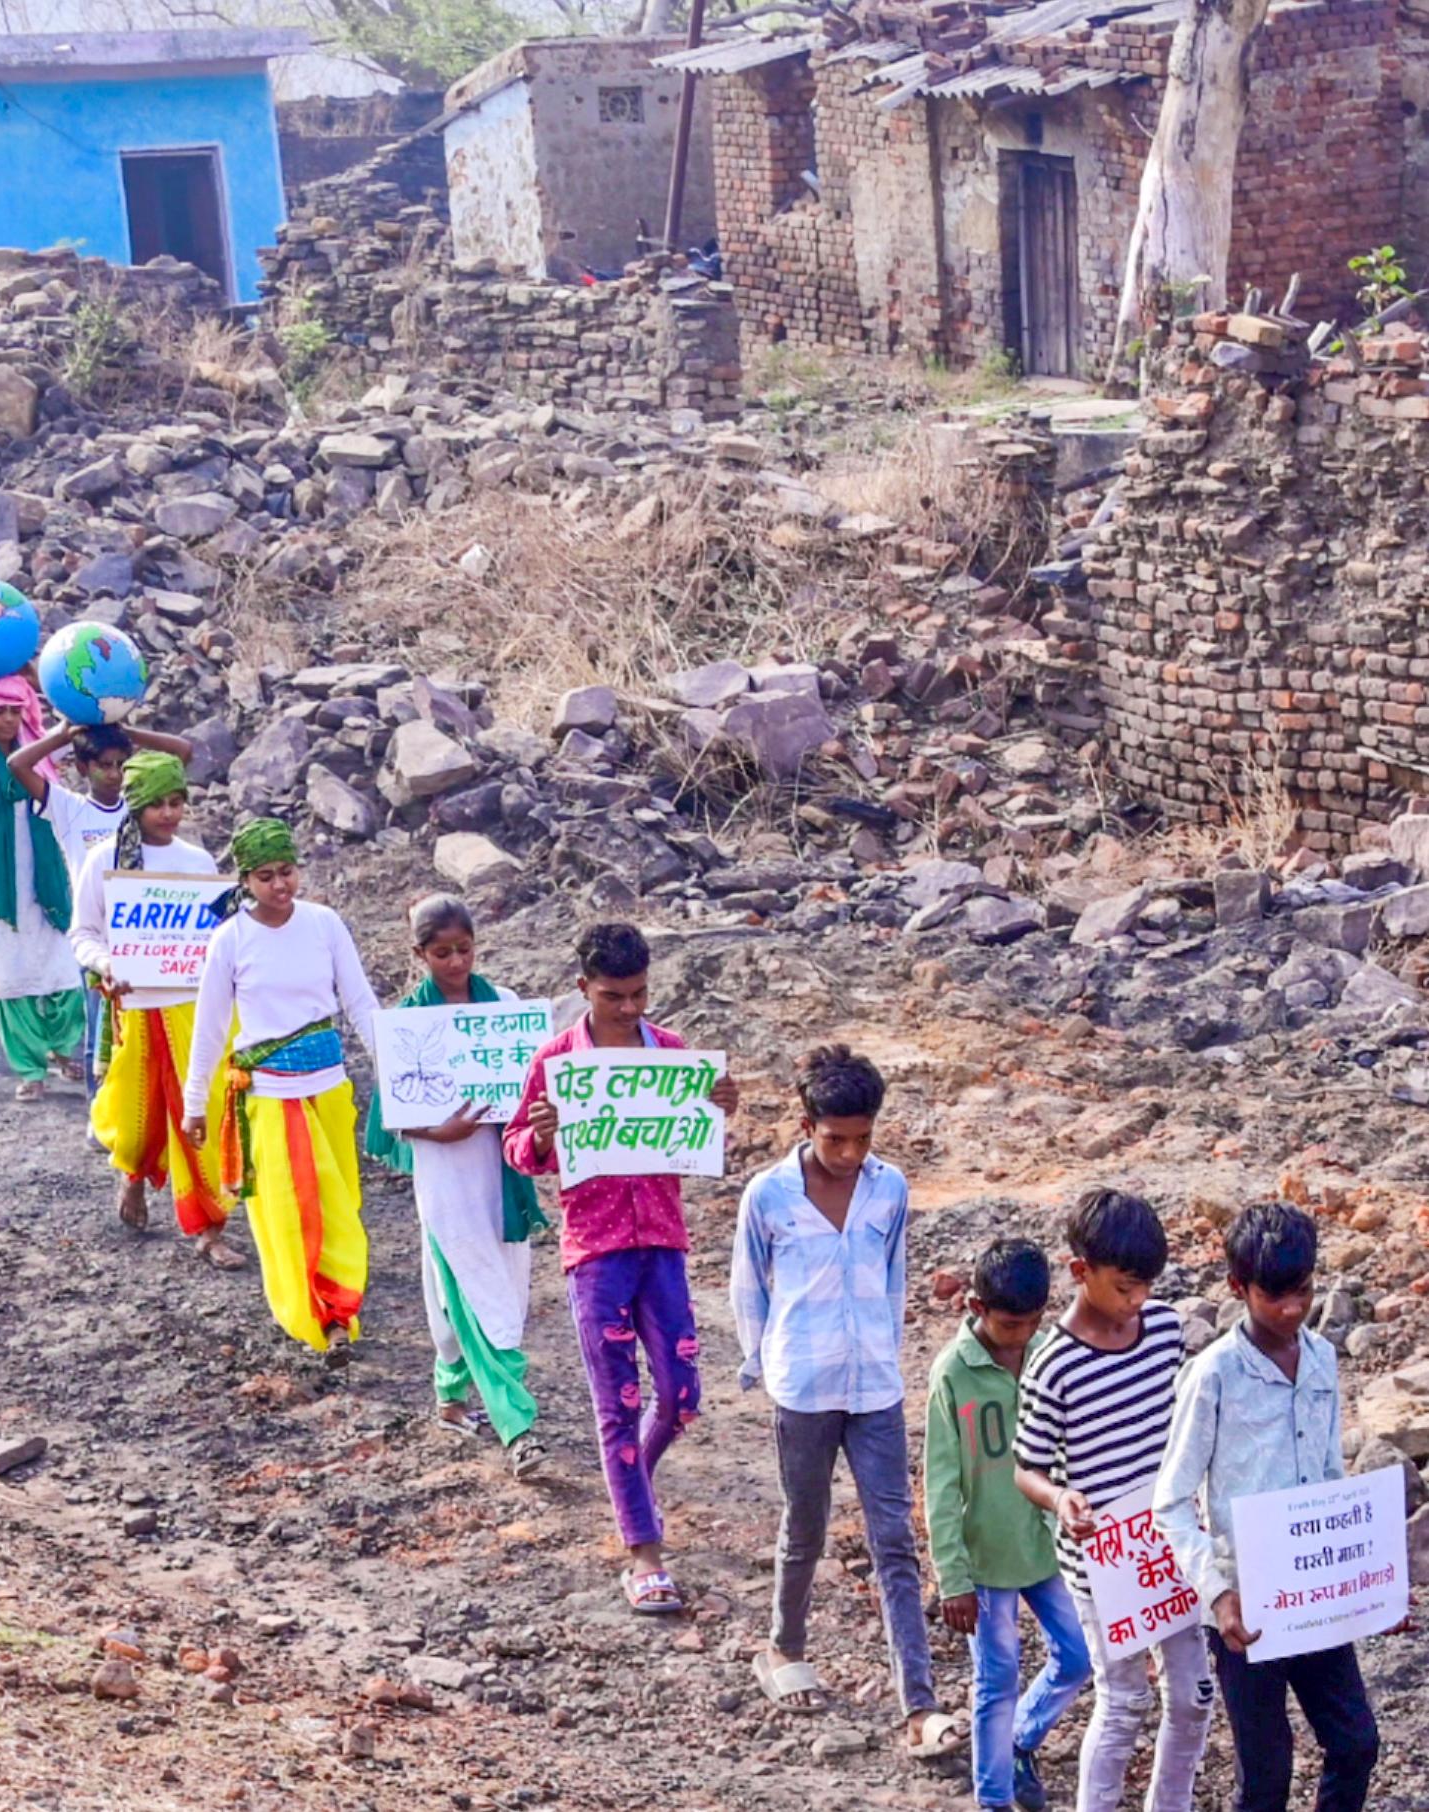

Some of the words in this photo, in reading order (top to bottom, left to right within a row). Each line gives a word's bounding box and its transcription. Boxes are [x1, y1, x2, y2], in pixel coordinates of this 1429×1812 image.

[110, 902, 192, 929] EARTH
[111, 943, 140, 956] LET
[144, 944, 179, 957] LOVE
[159, 960, 198, 975] SAVE
[554, 1060, 600, 1108] पेड़
[606, 1058, 718, 1107] लगाओ
[560, 1104, 618, 1173] पृथ्वी
[959, 1399, 1008, 1458] 10
[1324, 1504, 1362, 1530] कहती
[1274, 1588, 1304, 1610] मेरा
[1308, 1585, 1335, 1603] रूप
[1107, 1617, 1137, 1644] का
